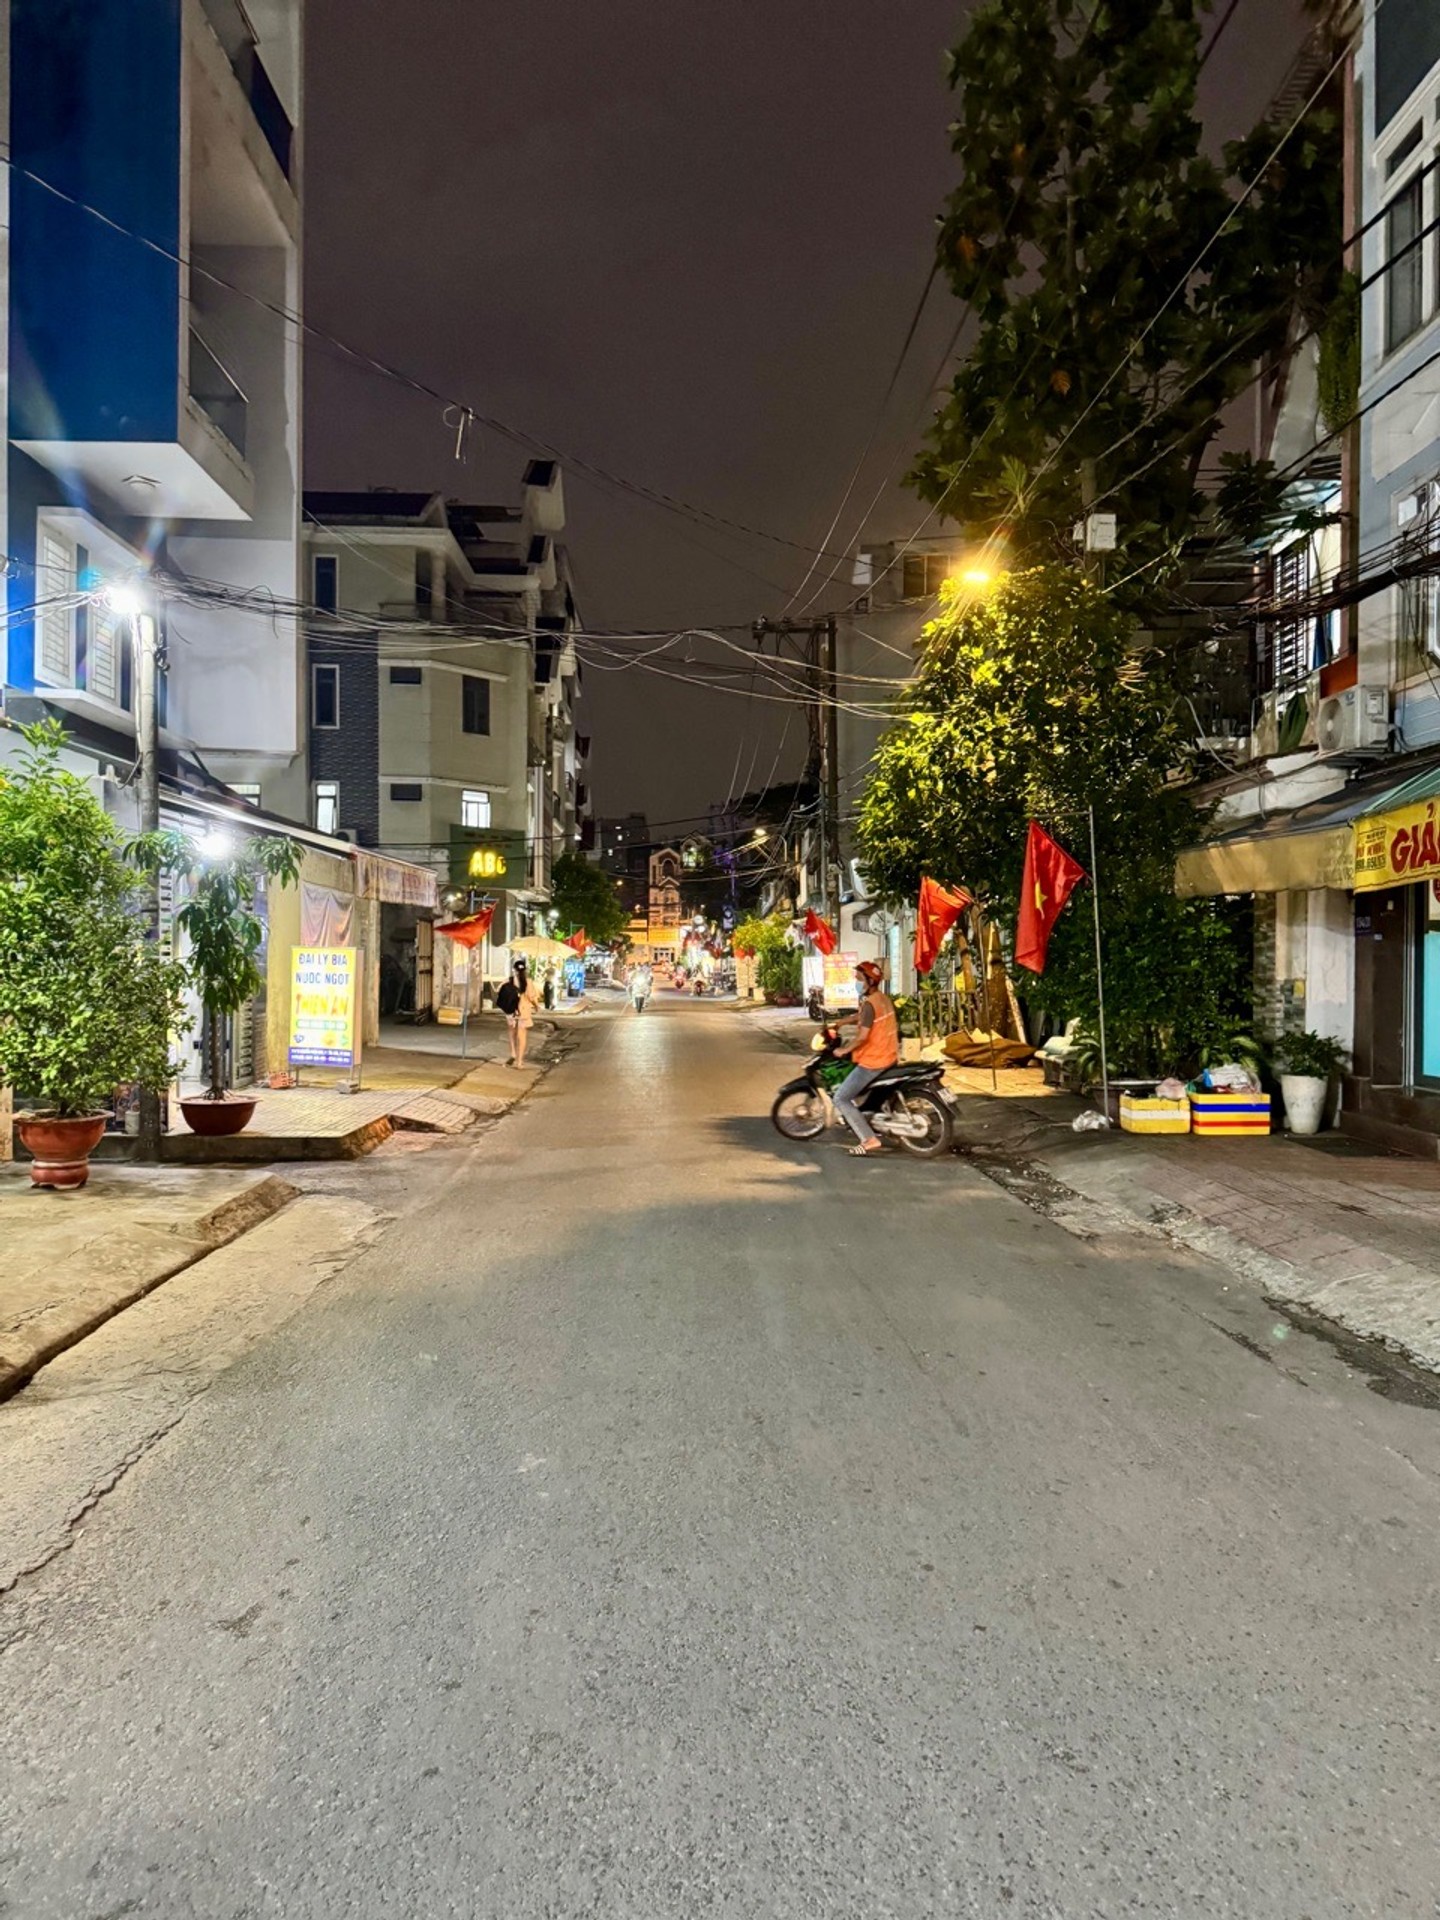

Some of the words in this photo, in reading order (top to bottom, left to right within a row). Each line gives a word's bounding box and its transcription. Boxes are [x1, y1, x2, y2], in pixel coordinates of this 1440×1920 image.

[1391, 802, 1440, 874] GIẢ
[469, 850, 507, 877] ABC
[331, 953, 348, 966] BIA
